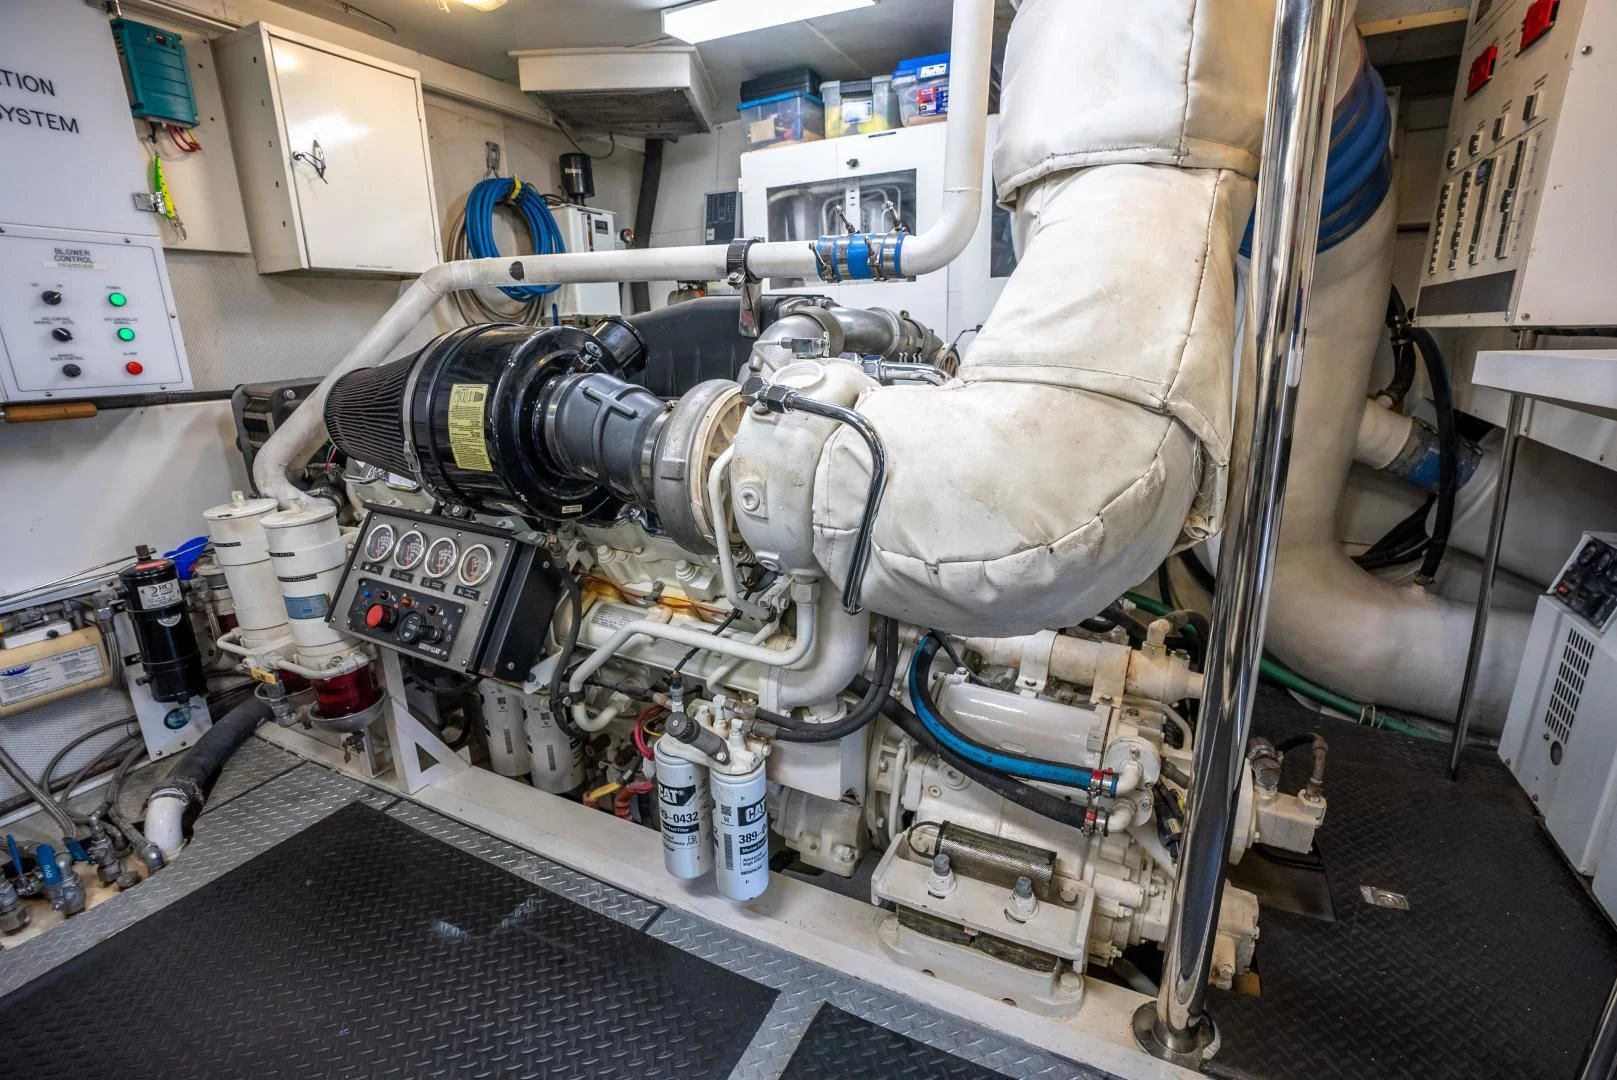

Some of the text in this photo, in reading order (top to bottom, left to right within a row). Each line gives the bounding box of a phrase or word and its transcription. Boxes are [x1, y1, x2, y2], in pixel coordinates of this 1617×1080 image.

[0, 69, 55, 96] TION
[53, 247, 91, 257] BLOWER
[54, 255, 95, 264] CONTROL
